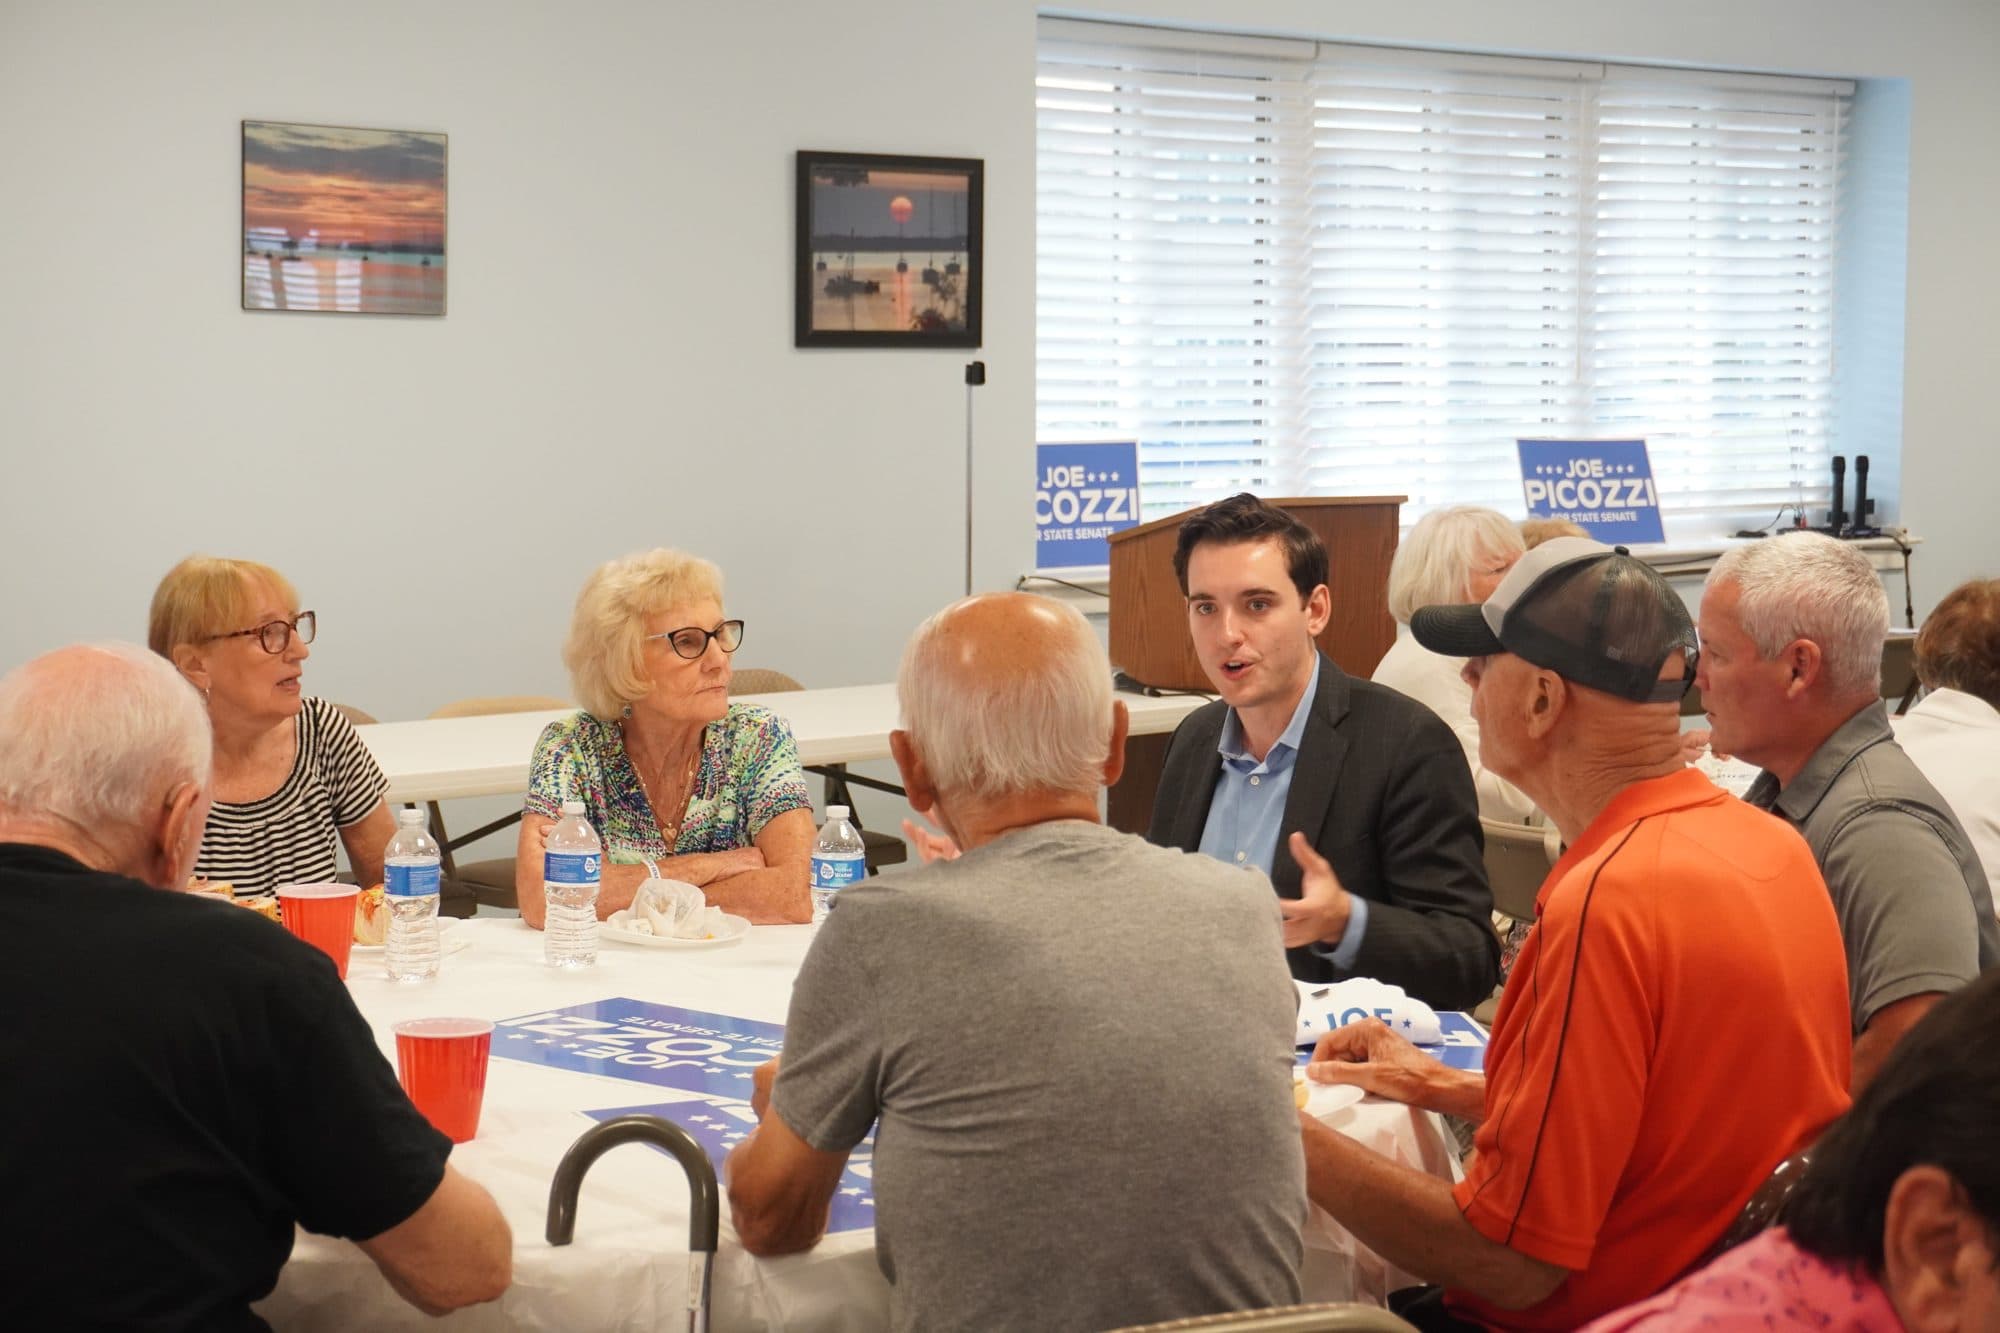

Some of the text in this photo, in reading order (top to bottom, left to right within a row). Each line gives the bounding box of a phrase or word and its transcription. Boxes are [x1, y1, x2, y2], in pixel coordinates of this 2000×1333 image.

[1042, 465, 1085, 488] JOE
[1565, 459, 1605, 478] JOE
[1524, 477, 1657, 509] PICOZZI
[1035, 488, 1138, 525] COZZI
[1571, 512, 1600, 523] STATE
[1600, 511, 1637, 522] SENATE
[1043, 528, 1073, 541] STATE
[1075, 526, 1114, 540] SENATE
[496, 1012, 778, 1067] COZZI
[618, 1016, 784, 1049] TATE SENATE
[572, 1045, 707, 1070] JOE
